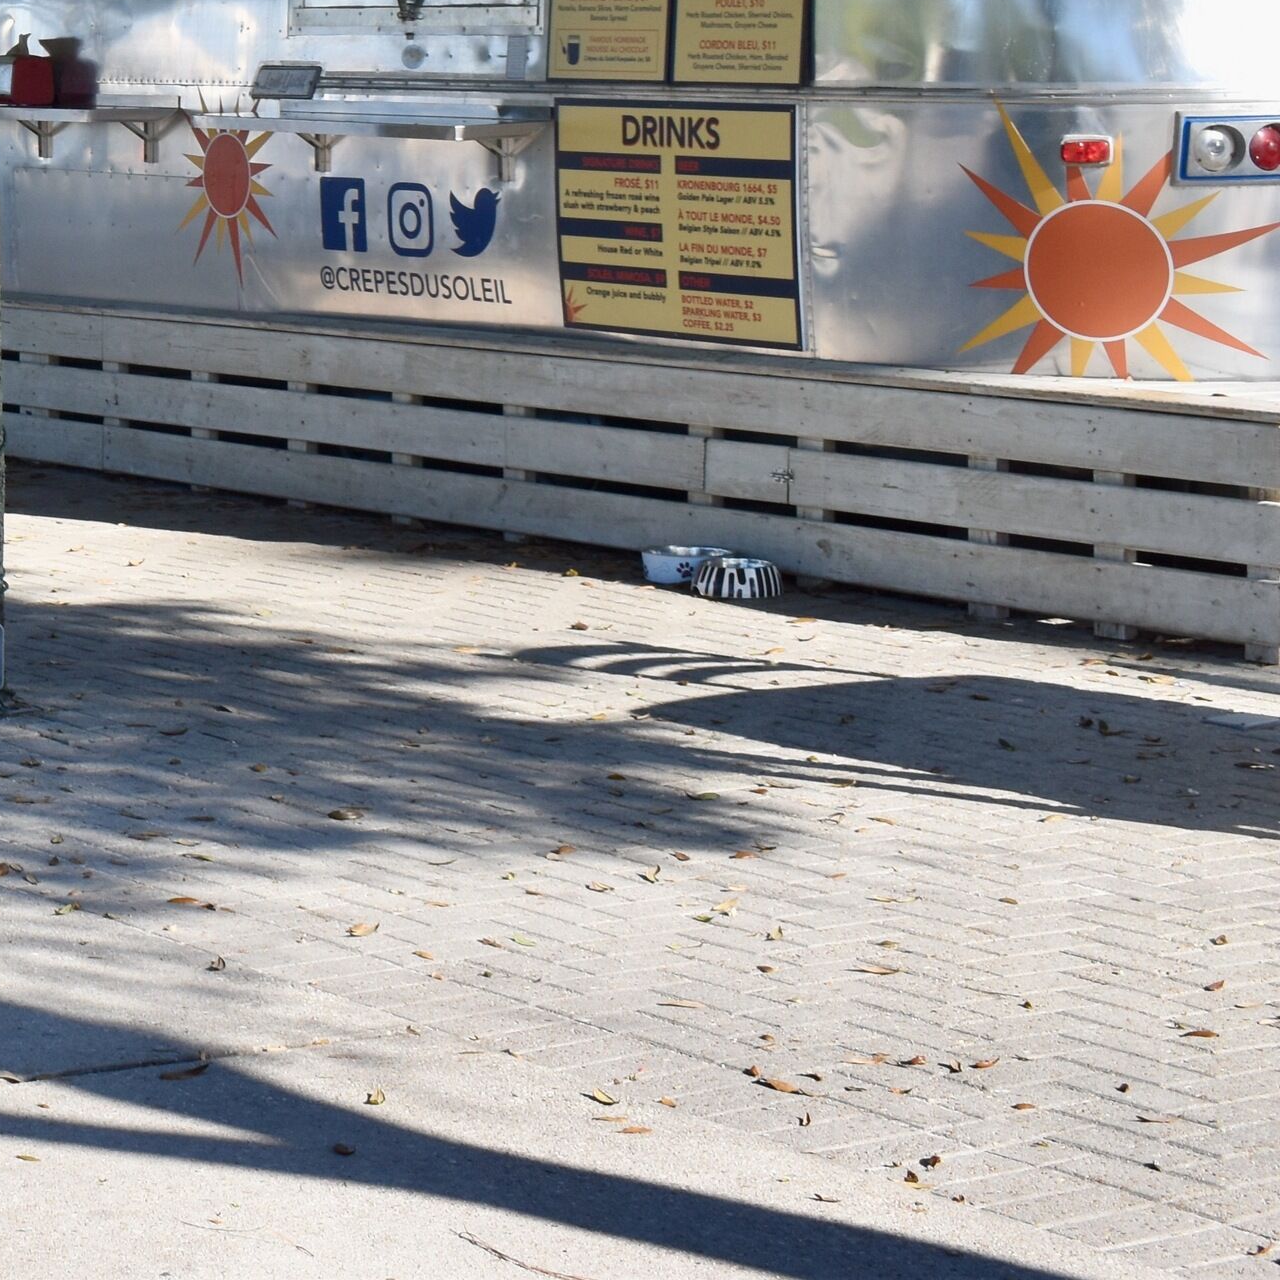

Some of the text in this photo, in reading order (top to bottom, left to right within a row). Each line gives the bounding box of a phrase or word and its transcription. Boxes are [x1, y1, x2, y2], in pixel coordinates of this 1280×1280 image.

[699, 40, 776, 51] CORDON BLEU, $11
[621, 114, 720, 150] DRINKS
[645, 178, 659, 190] $11
[677, 179, 778, 194] KRONENBOURG 1664, $5
[564, 188, 570, 196] A
[571, 188, 604, 201] refreshing
[606, 190, 626, 200] frozen
[644, 193, 660, 202] wine
[677, 192, 700, 201] Golden
[701, 193, 714, 202] Pale
[716, 194, 734, 205] Lager
[742, 196, 757, 204] ABV
[563, 201, 660, 216] slush with strawberry & peach
[685, 210, 708, 221] TOUT
[709, 212, 719, 222] LE
[721, 213, 755, 225] MONDE,
[758, 215, 781, 226] $4.50
[679, 223, 702, 234] Belgian
[702, 225, 719, 235] Style
[720, 226, 740, 234] Saison
[749, 228, 764, 236] ABV
[597, 245, 618, 254] House
[620, 246, 633, 255] Red
[643, 247, 663, 257] White
[679, 242, 767, 258] LA FIN DU MONDE, $7
[679, 254, 703, 266] Belgian
[729, 259, 744, 267] ABV
[320, 265, 512, 305] @CREPESDUSOLEIL
[586, 286, 666, 304] Orange juice and bubbly
[681, 294, 754, 309] BOTTLED WATER, $2
[682, 306, 762, 322] SPARKLING WATER, $3
[682, 318, 734, 332] COFFEE, $2.25
